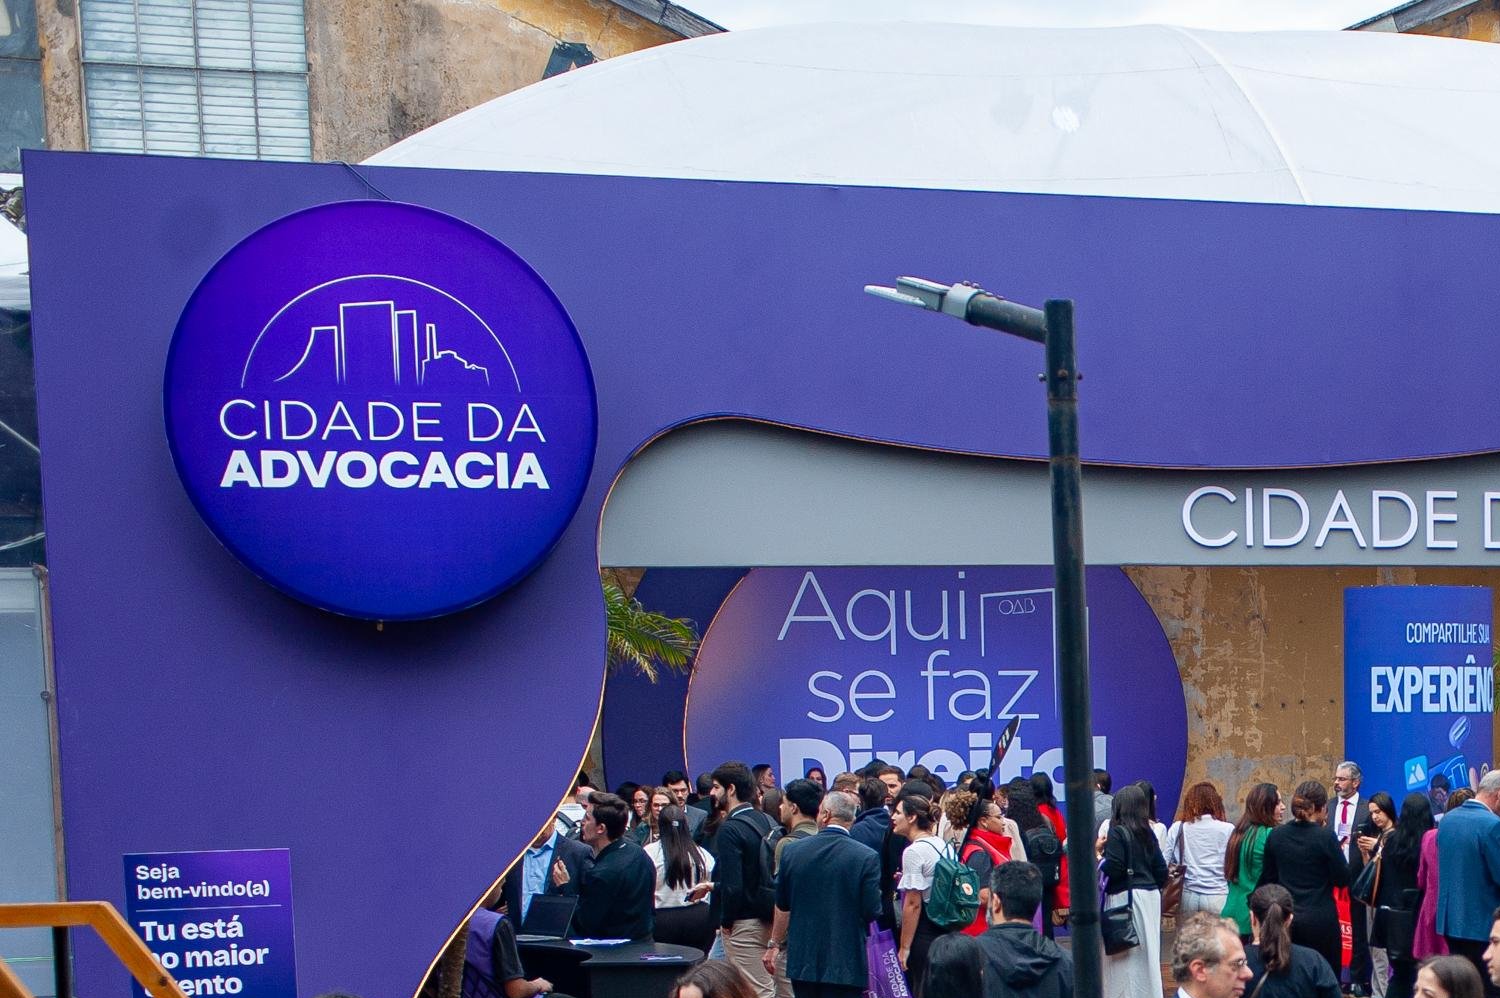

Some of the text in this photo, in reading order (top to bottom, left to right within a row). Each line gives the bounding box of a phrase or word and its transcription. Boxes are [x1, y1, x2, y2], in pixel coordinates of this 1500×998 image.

[219, 399, 546, 443] CIDADE DA
[219, 450, 550, 489] ADVOCACIA
[1182, 486, 1459, 550] CIDADE
[777, 571, 966, 656] Aqui
[1406, 622, 1477, 644] COMPARTILHE
[807, 650, 1040, 723] se faz
[136, 863, 180, 883] Seja
[137, 880, 270, 900] bem-vindo(a)
[139, 914, 244, 942] Tu está
[185, 943, 270, 968] maior
[144, 974, 243, 998] ento
[888, 948, 908, 997] ADVOCACIA
